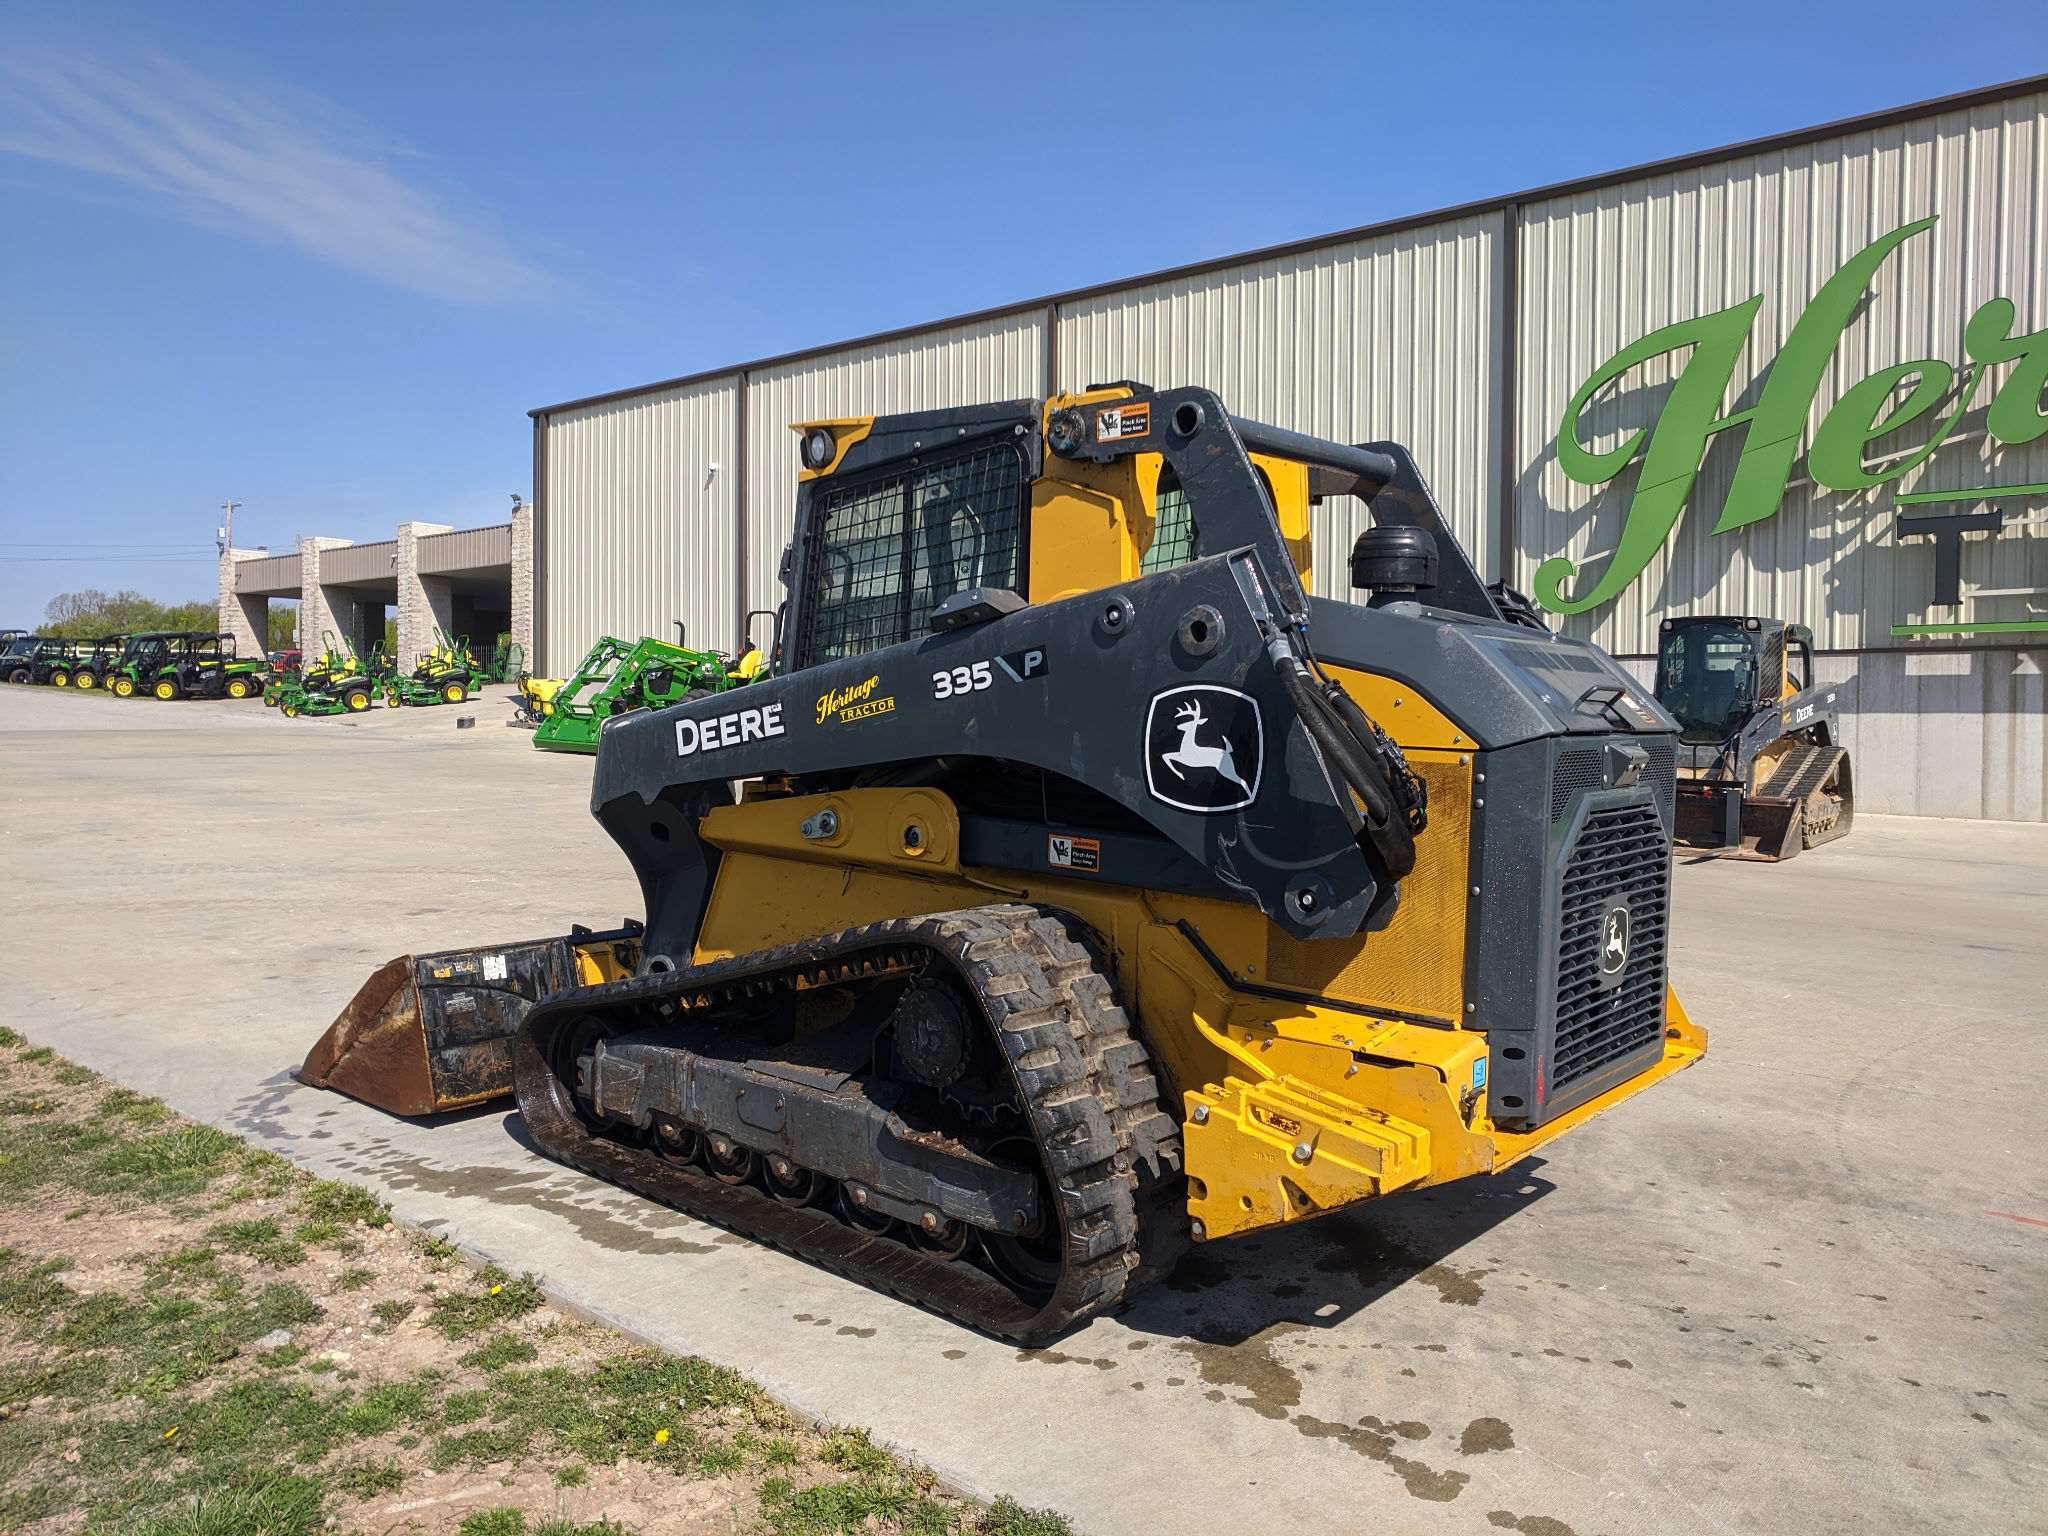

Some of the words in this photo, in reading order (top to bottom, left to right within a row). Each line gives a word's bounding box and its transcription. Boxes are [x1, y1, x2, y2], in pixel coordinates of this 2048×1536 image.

[932, 660, 993, 699] 335
[816, 675, 880, 725] Heritage
[840, 699, 895, 721] TRACTOR
[1797, 704, 1814, 723] DEERE
[675, 703, 785, 756] DEERE
